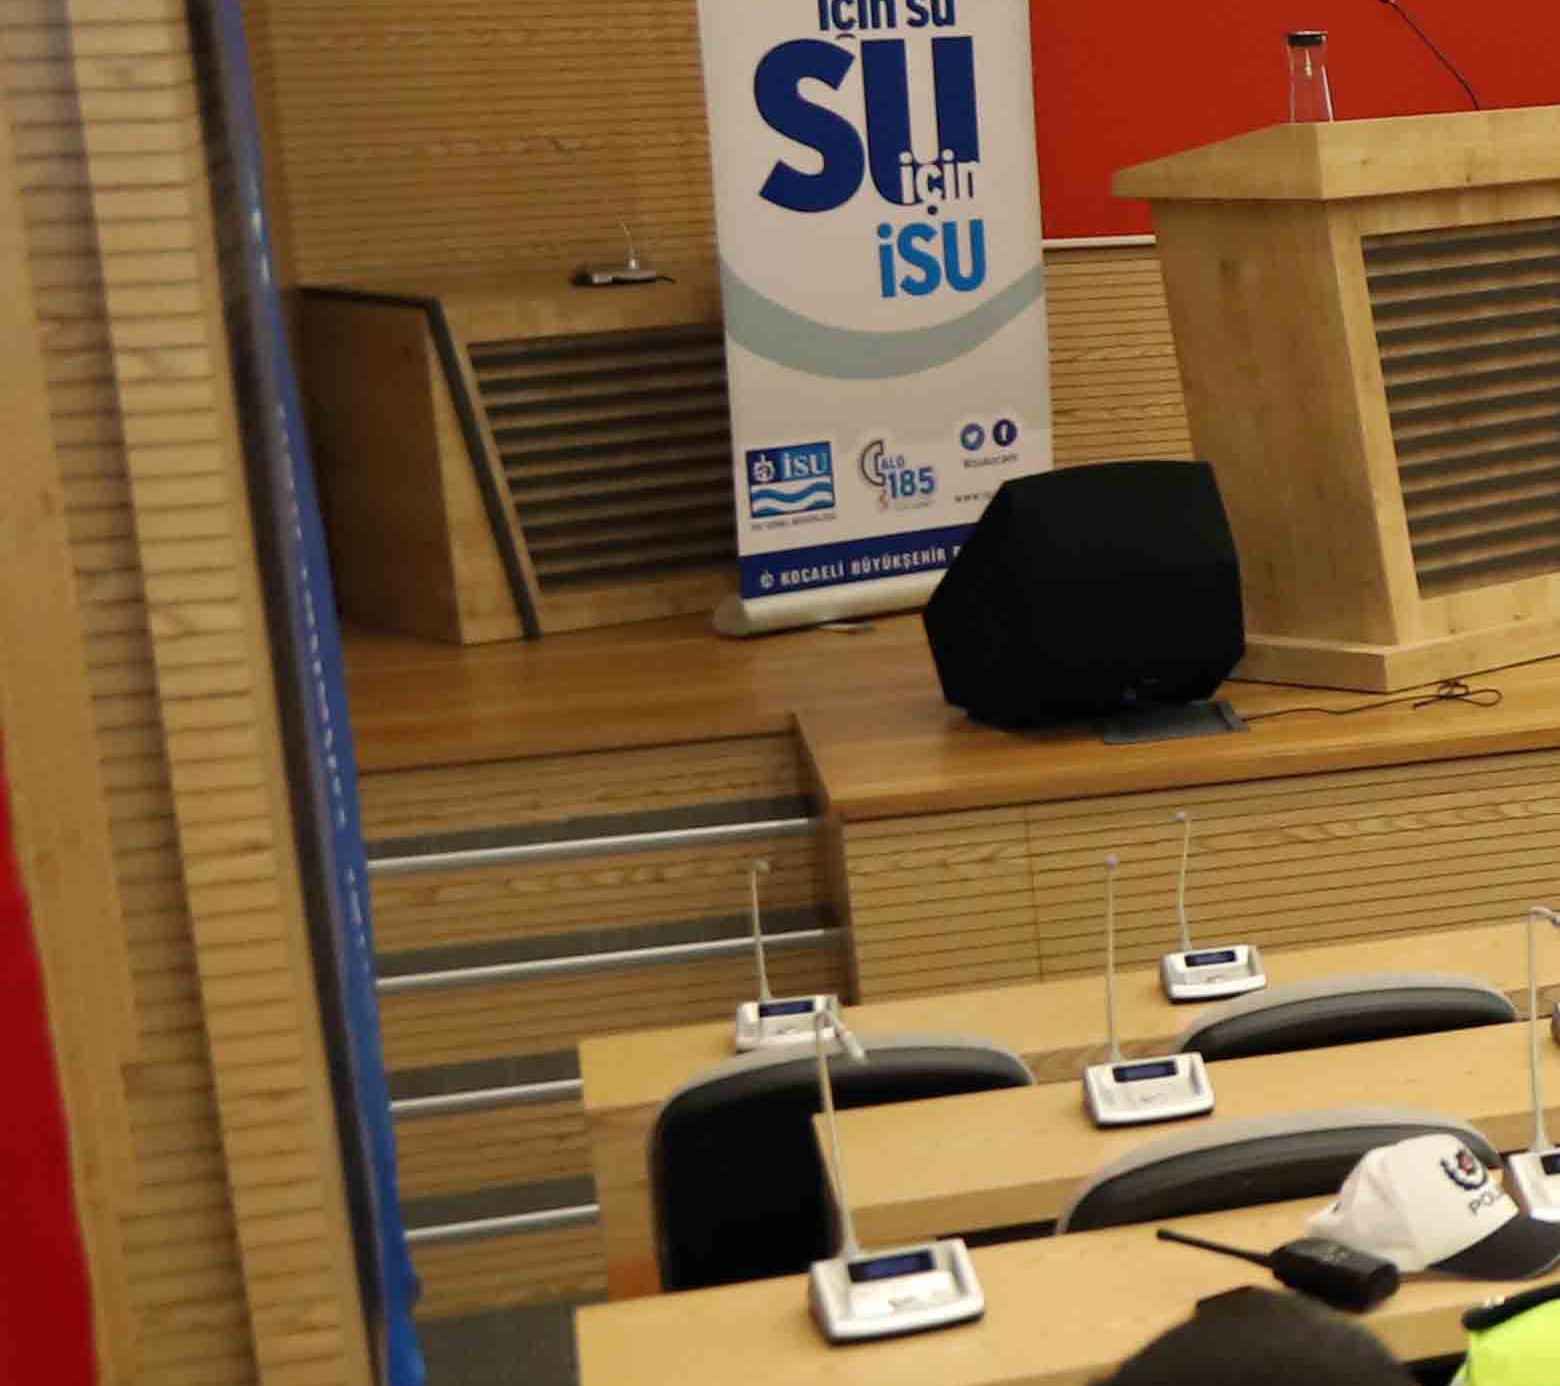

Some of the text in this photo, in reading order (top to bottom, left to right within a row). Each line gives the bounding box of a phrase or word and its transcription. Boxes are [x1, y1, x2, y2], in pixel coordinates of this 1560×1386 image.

[753, 35, 980, 213] SU
[888, 467, 936, 499] 185
[780, 563, 845, 585] KOCAELİ
[851, 545, 947, 575] BÜYÜKŞEHİR
